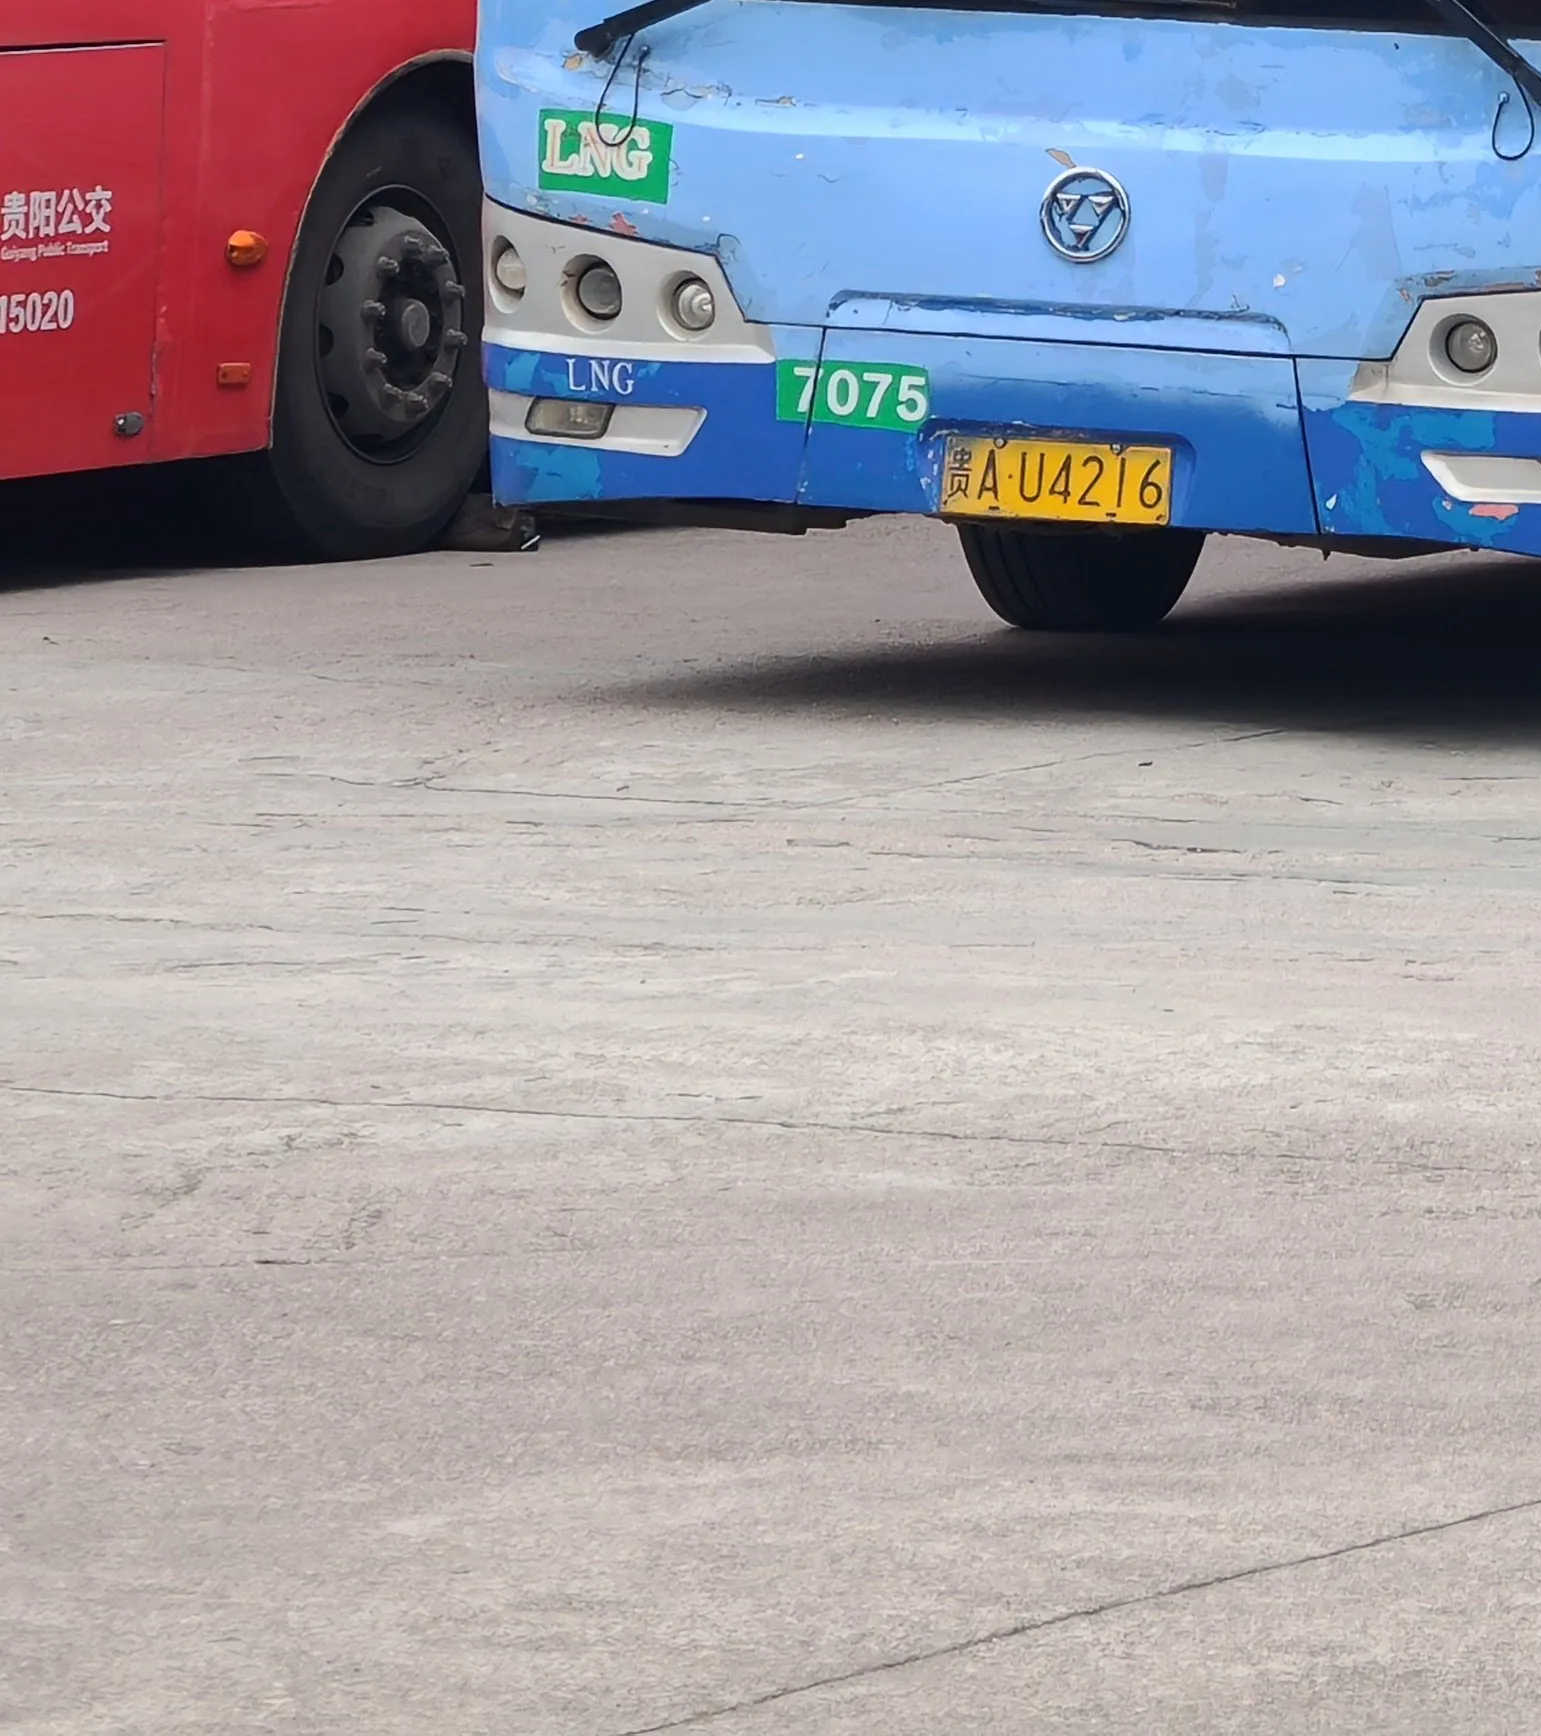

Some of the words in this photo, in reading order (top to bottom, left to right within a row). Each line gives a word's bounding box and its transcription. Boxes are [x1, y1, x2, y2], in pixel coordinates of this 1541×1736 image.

[541, 119, 653, 181] LNG
[0, 185, 113, 241] 贵阳公交
[565, 358, 636, 395] LNG
[793, 366, 928, 422] 7075
